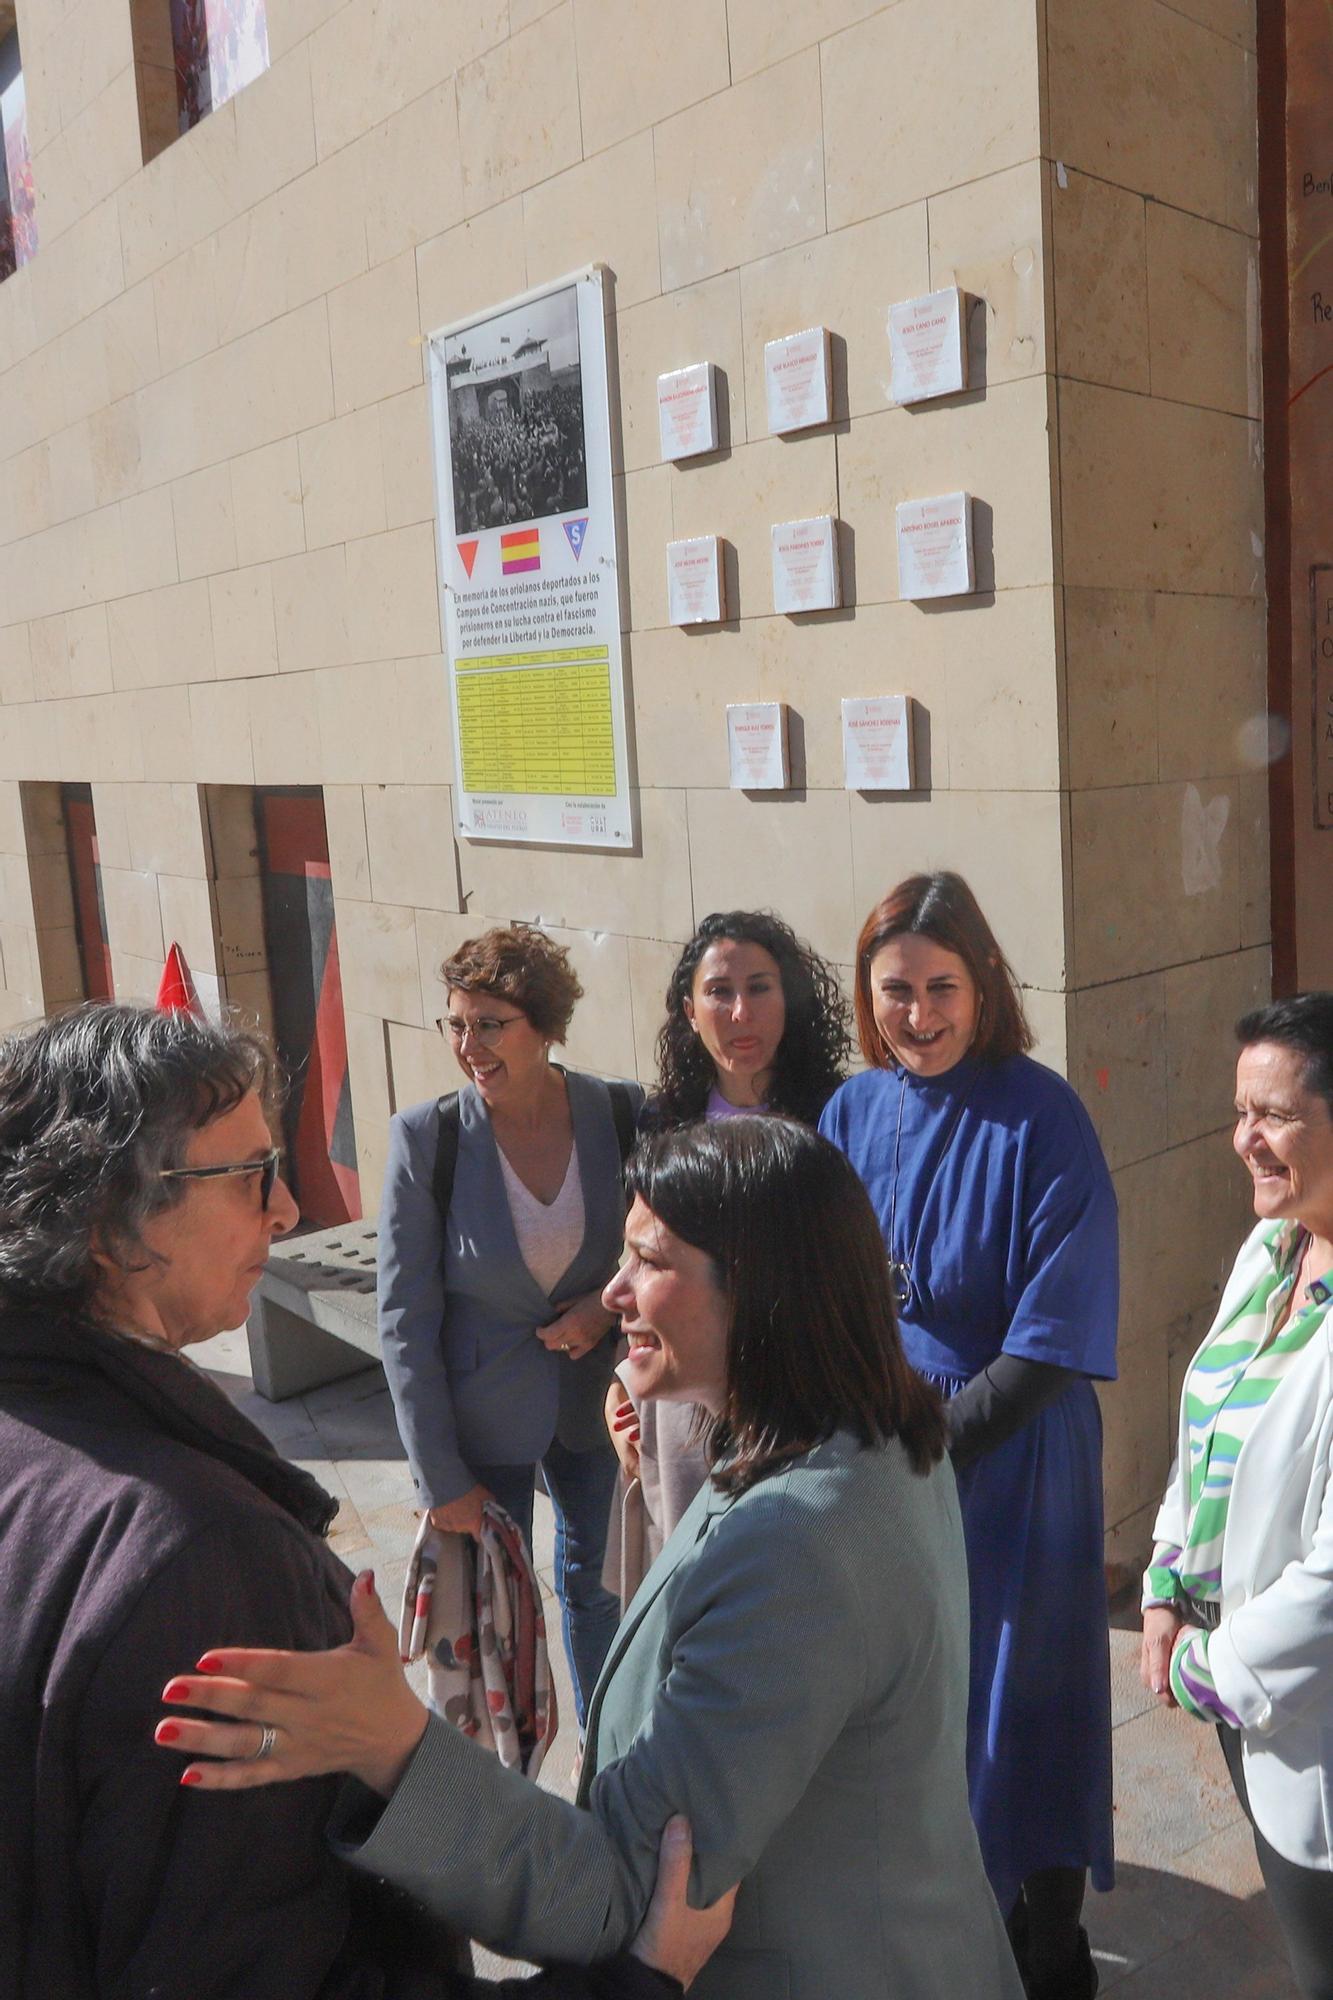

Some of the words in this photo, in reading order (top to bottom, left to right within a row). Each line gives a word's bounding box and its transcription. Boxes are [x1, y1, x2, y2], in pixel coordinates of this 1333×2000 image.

[571, 525, 581, 545] S
[453, 592, 462, 604] En
[462, 589, 489, 602] memoria
[490, 586, 498, 599] de
[499, 584, 509, 597] los
[510, 581, 540, 596] oriolanos
[542, 575, 581, 592] deportados
[583, 575, 588, 585] a
[589, 571, 600, 583] los
[456, 607, 481, 618] Campos
[482, 604, 489, 615] de
[490, 597, 538, 614] Concentración
[539, 595, 559, 607] nazis,
[560, 593, 574, 606] que
[575, 590, 599, 602] fueron
[460, 620, 494, 635] prisioneros
[495, 620, 503, 629] en
[504, 619, 512, 628] su
[513, 614, 531, 627] lucha
[532, 612, 555, 624] contra
[556, 610, 563, 621] el
[564, 607, 597, 620] fascismo
[462, 639, 472, 650] por
[473, 634, 502, 647] defender
[502, 633, 509, 644] la
[509, 629, 537, 643] Libertad
[538, 631, 542, 643] y
[543, 628, 550, 639] la
[551, 623, 595, 638] Democracia.
